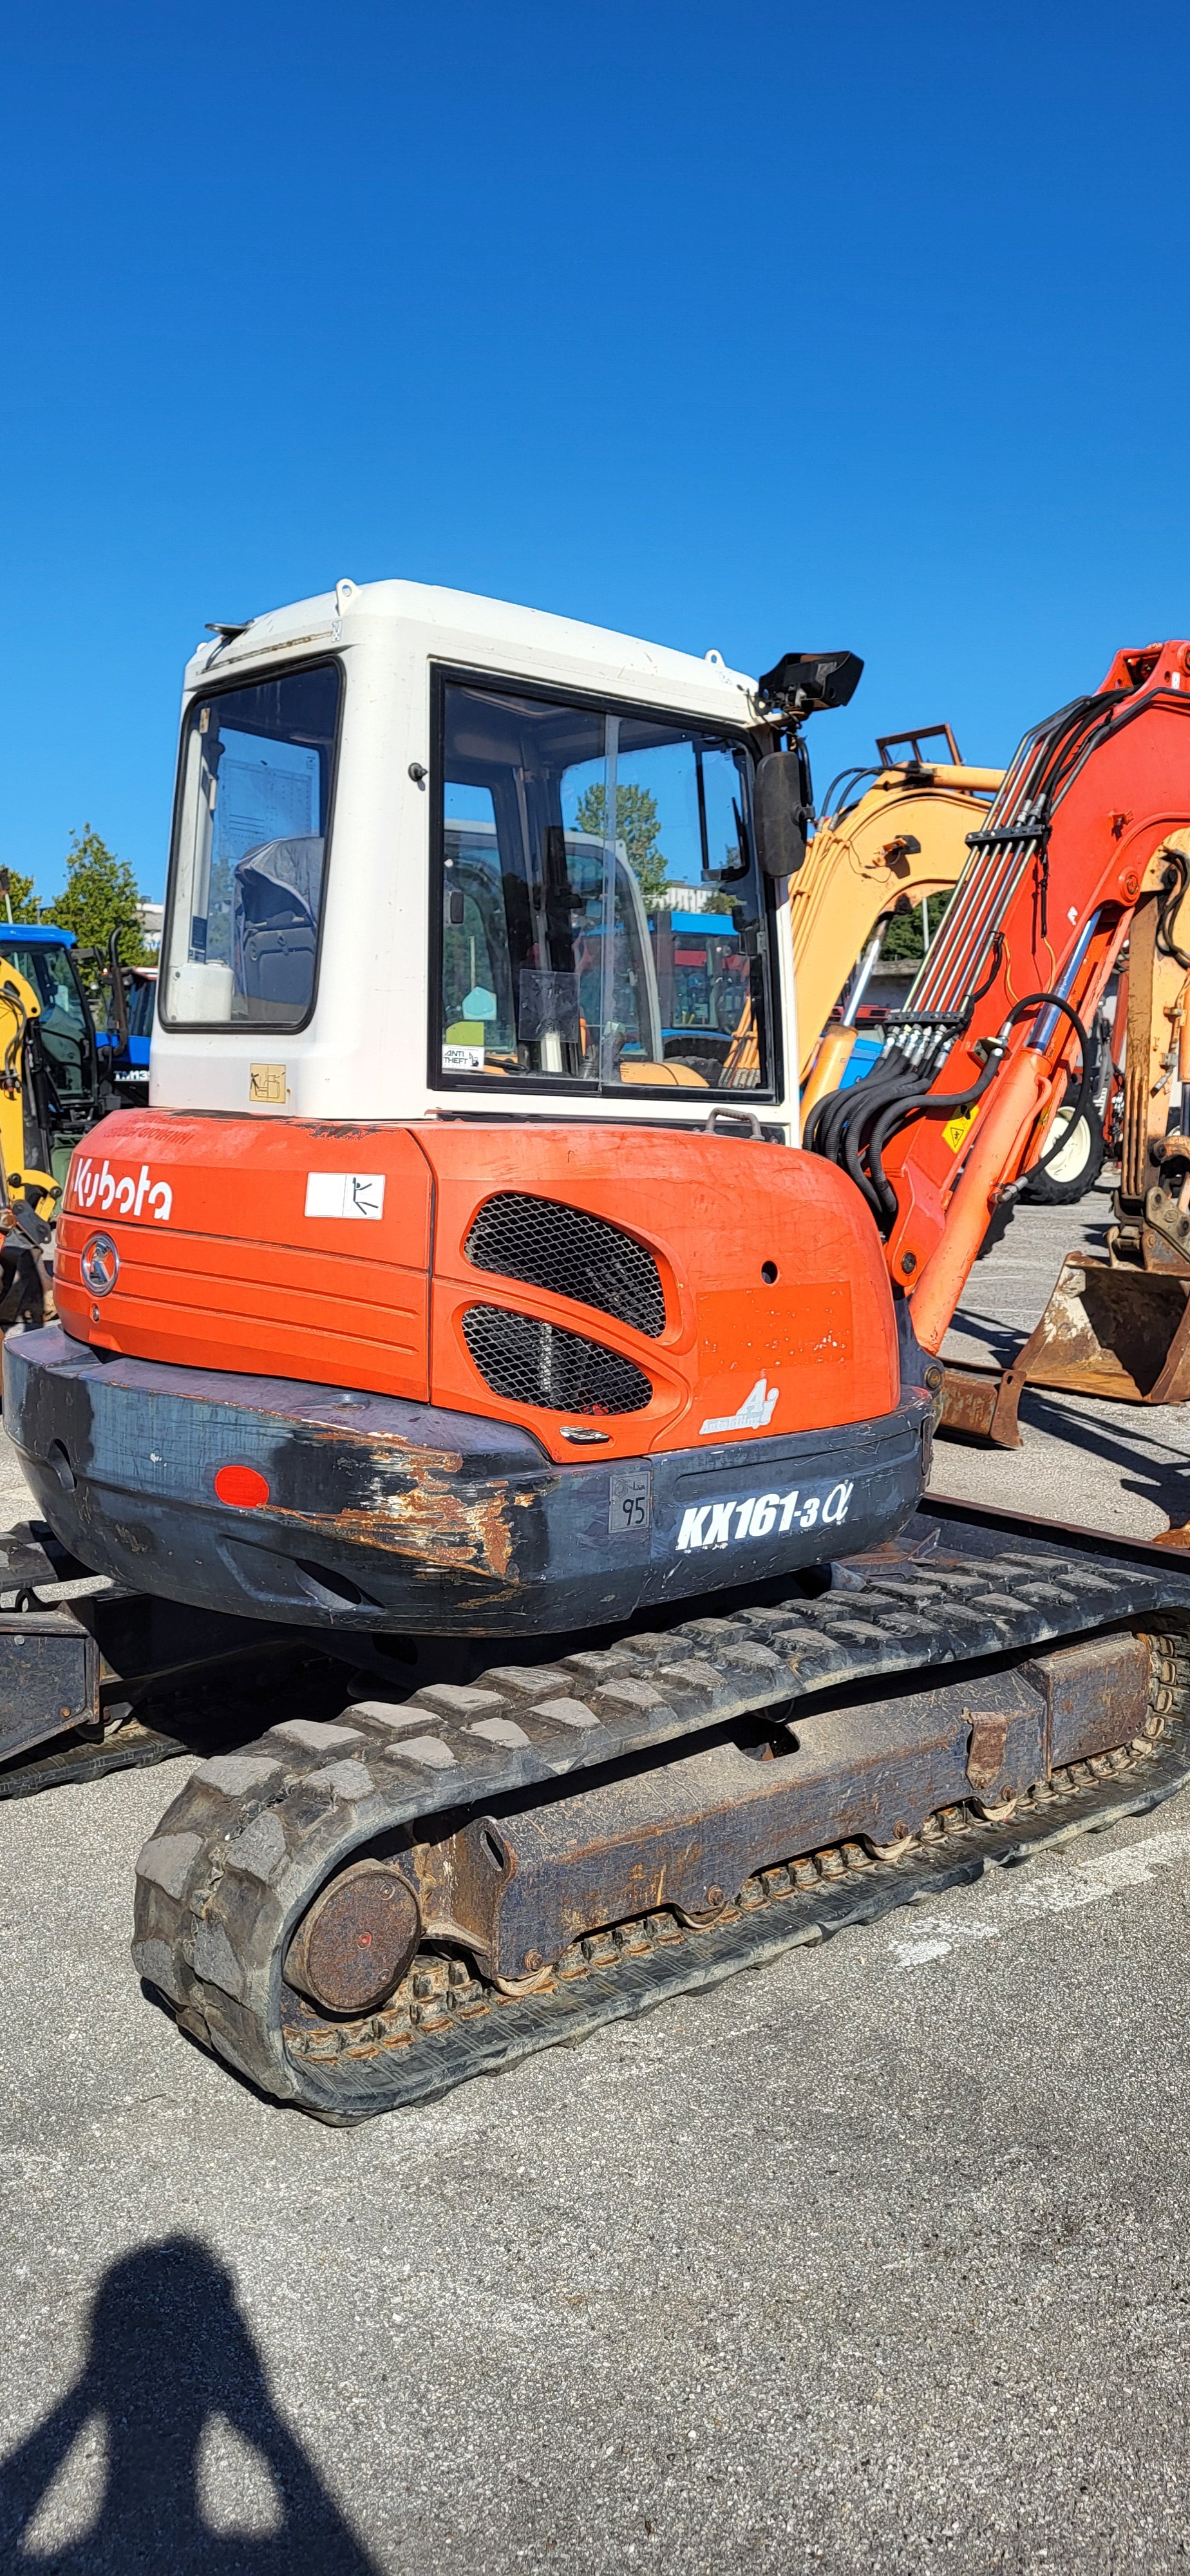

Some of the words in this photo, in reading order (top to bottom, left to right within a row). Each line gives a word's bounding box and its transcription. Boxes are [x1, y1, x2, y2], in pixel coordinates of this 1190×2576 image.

[135, 1127, 194, 1145] GIOVANNI
[74, 1158, 173, 1220] Kubota
[622, 1496, 646, 1526] 95
